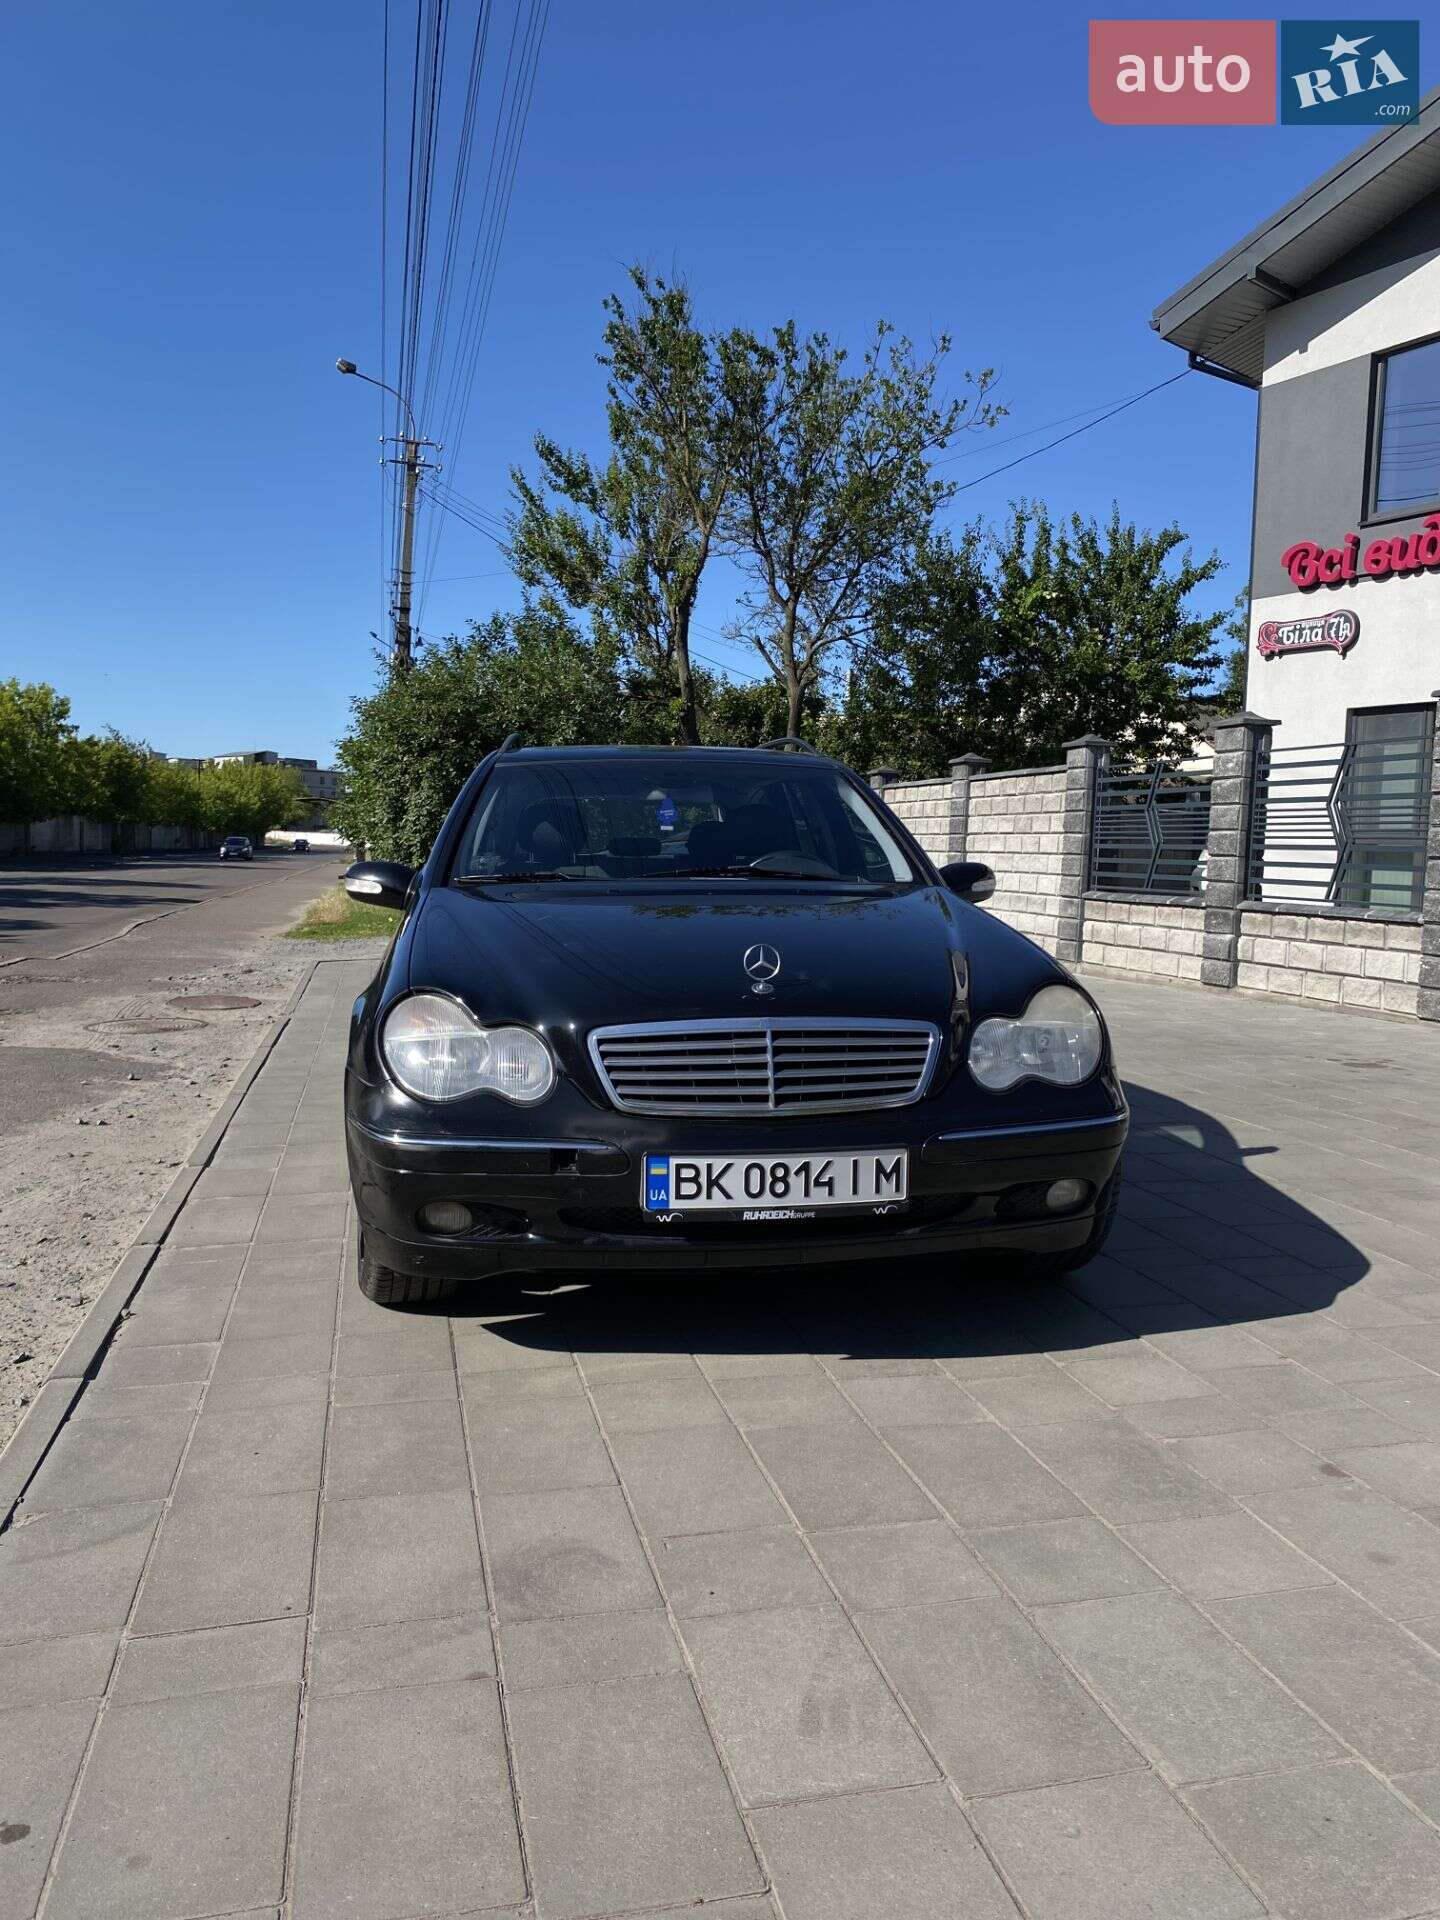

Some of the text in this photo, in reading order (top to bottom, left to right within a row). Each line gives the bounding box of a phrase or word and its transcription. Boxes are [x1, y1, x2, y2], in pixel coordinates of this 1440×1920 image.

[1281, 532, 1359, 588] Всі
[650, 1189, 667, 1201] UA
[674, 1162, 734, 1200] BK
[743, 1159, 834, 1199] 0814
